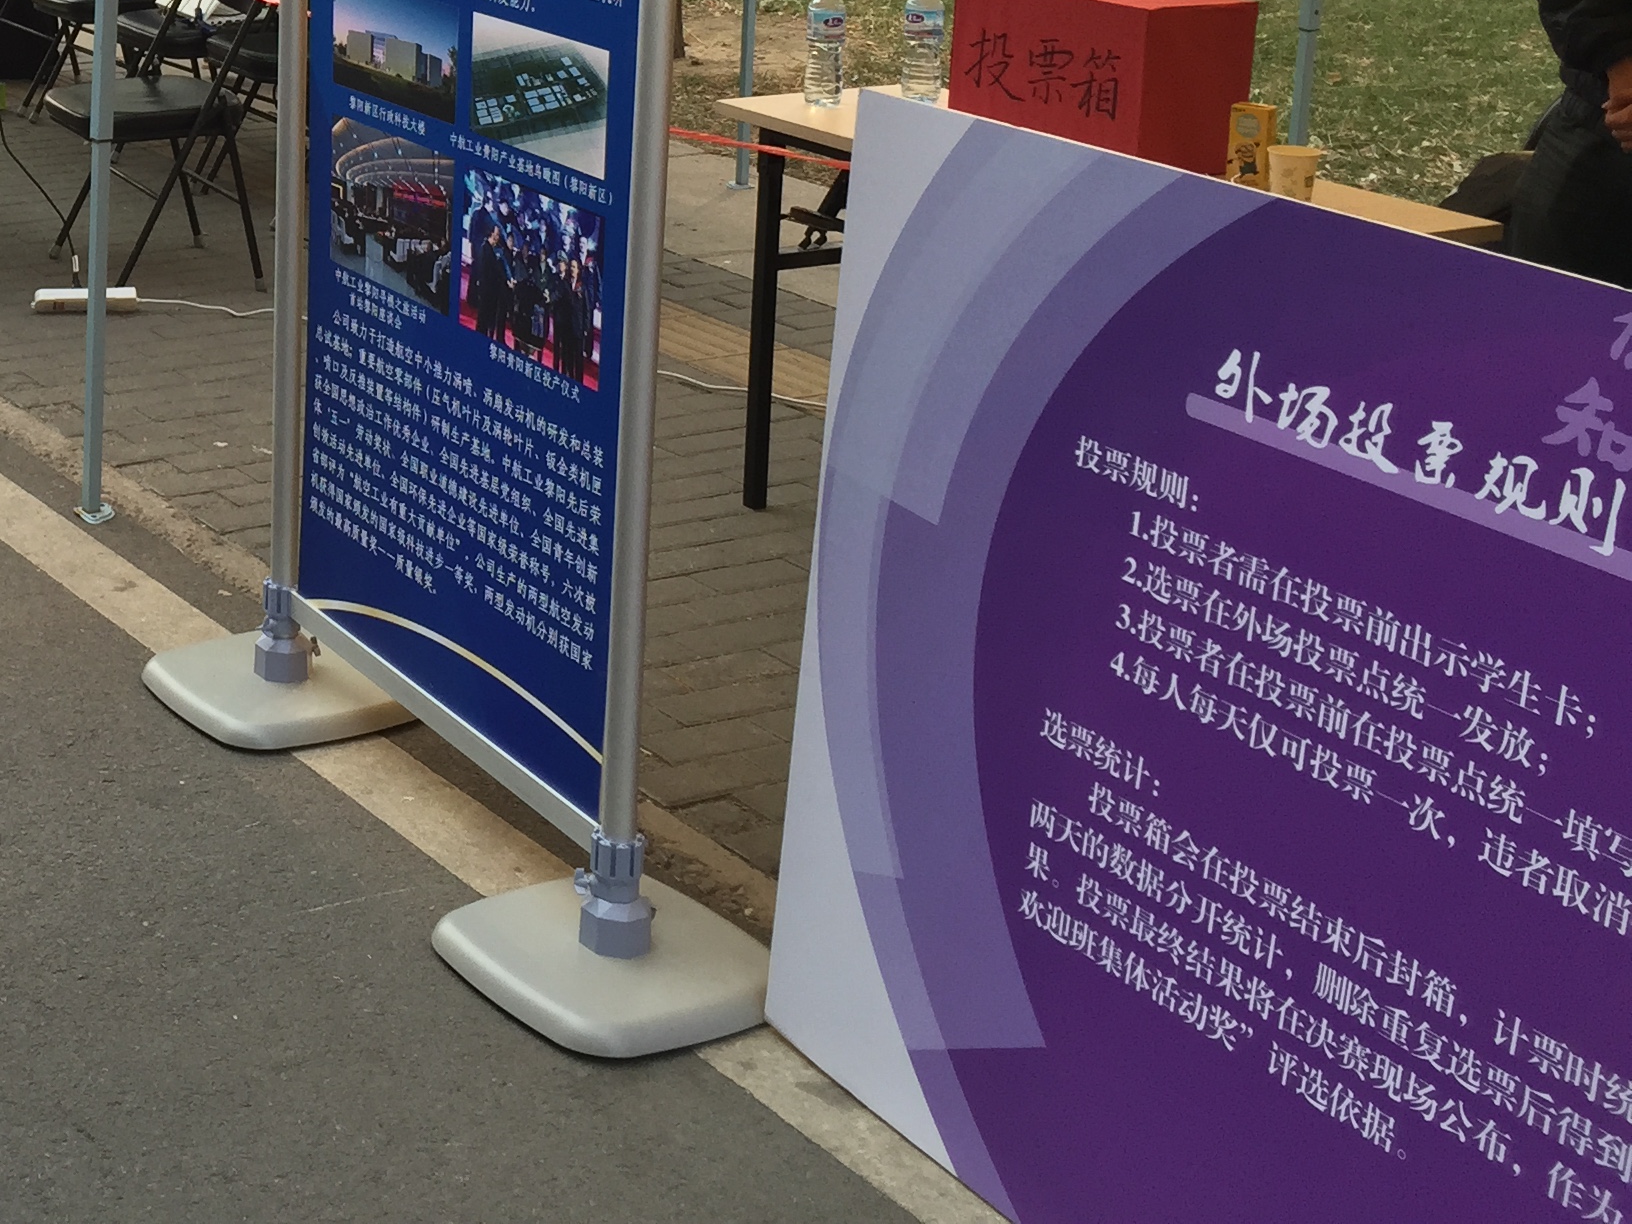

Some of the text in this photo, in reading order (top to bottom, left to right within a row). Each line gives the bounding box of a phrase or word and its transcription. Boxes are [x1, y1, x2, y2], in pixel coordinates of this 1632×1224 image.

[964, 27, 1122, 121] 投票箱
[1075, 433, 1202, 514] 投票规则：
[1216, 347, 1626, 555] 外场投票规则
[1040, 707, 1161, 798] 选票统计：
